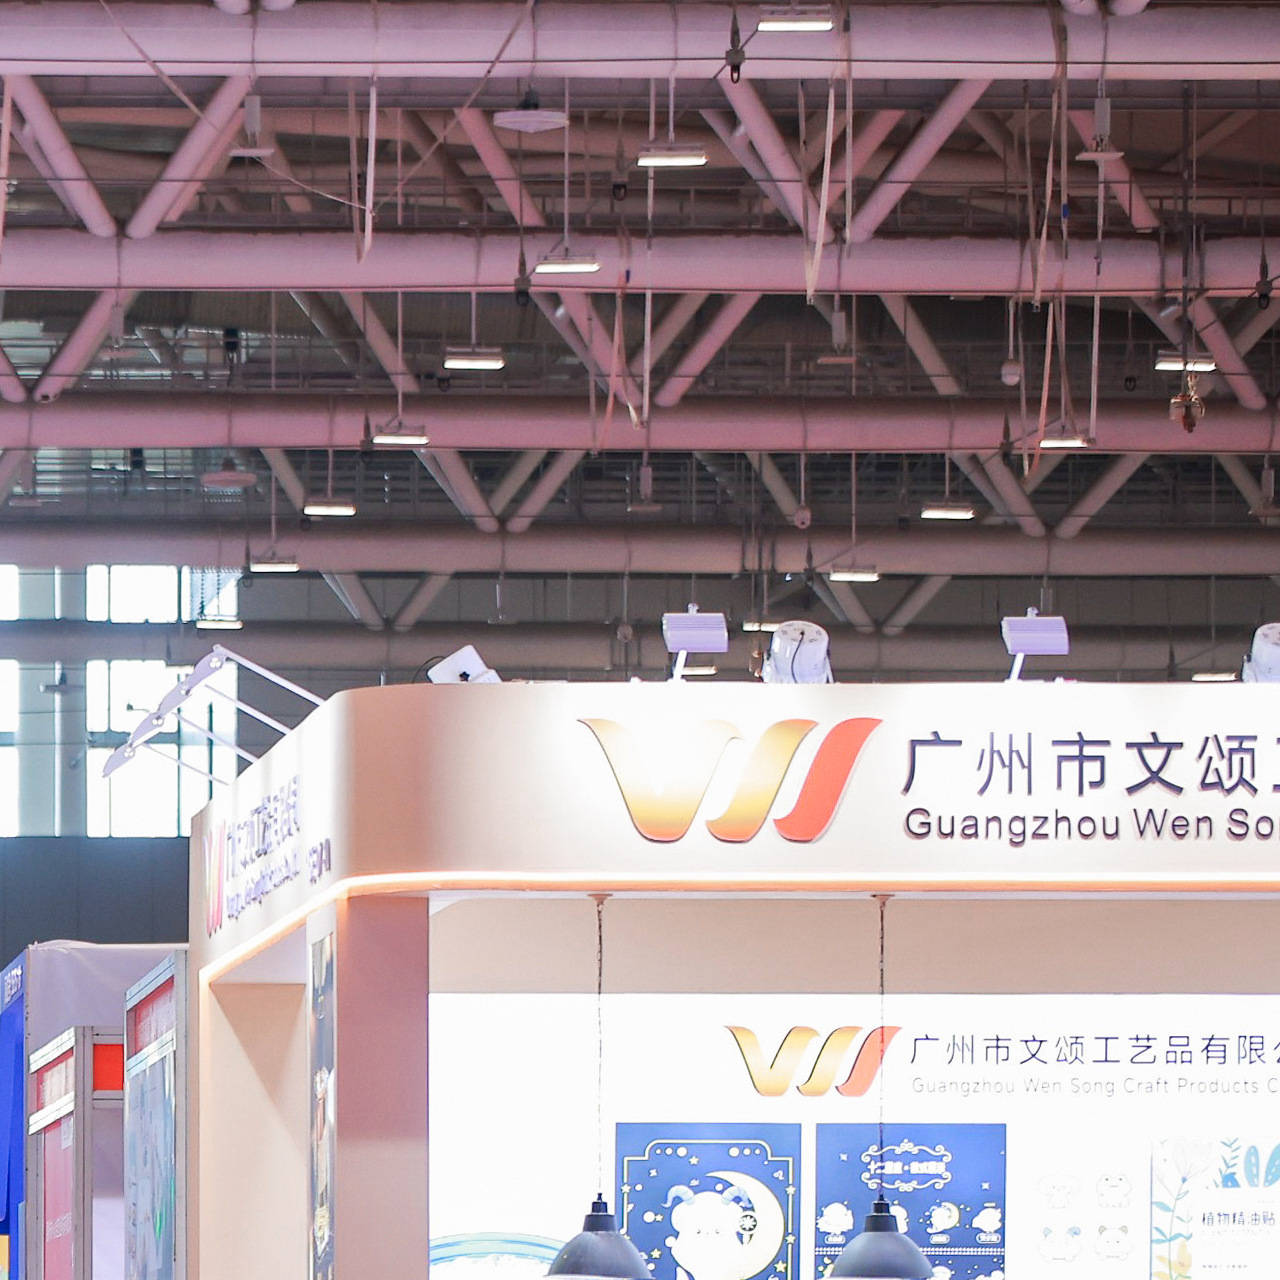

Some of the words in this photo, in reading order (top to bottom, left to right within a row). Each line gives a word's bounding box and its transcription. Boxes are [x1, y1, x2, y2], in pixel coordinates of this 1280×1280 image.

[902, 730, 1280, 798] 广州市文颂
[904, 808, 1120, 848] Guangzhou
[1134, 808, 1212, 840] Wen
[1229, 808, 1280, 840] So
[912, 1077, 1015, 1097] Guangzhou
[1024, 1077, 1061, 1093] Wen
[1070, 1077, 1115, 1097] Song
[1124, 1077, 1169, 1093] Craft
[1178, 1077, 1260, 1093] Products
[1202, 1211, 1276, 1226] 植物精油贴
